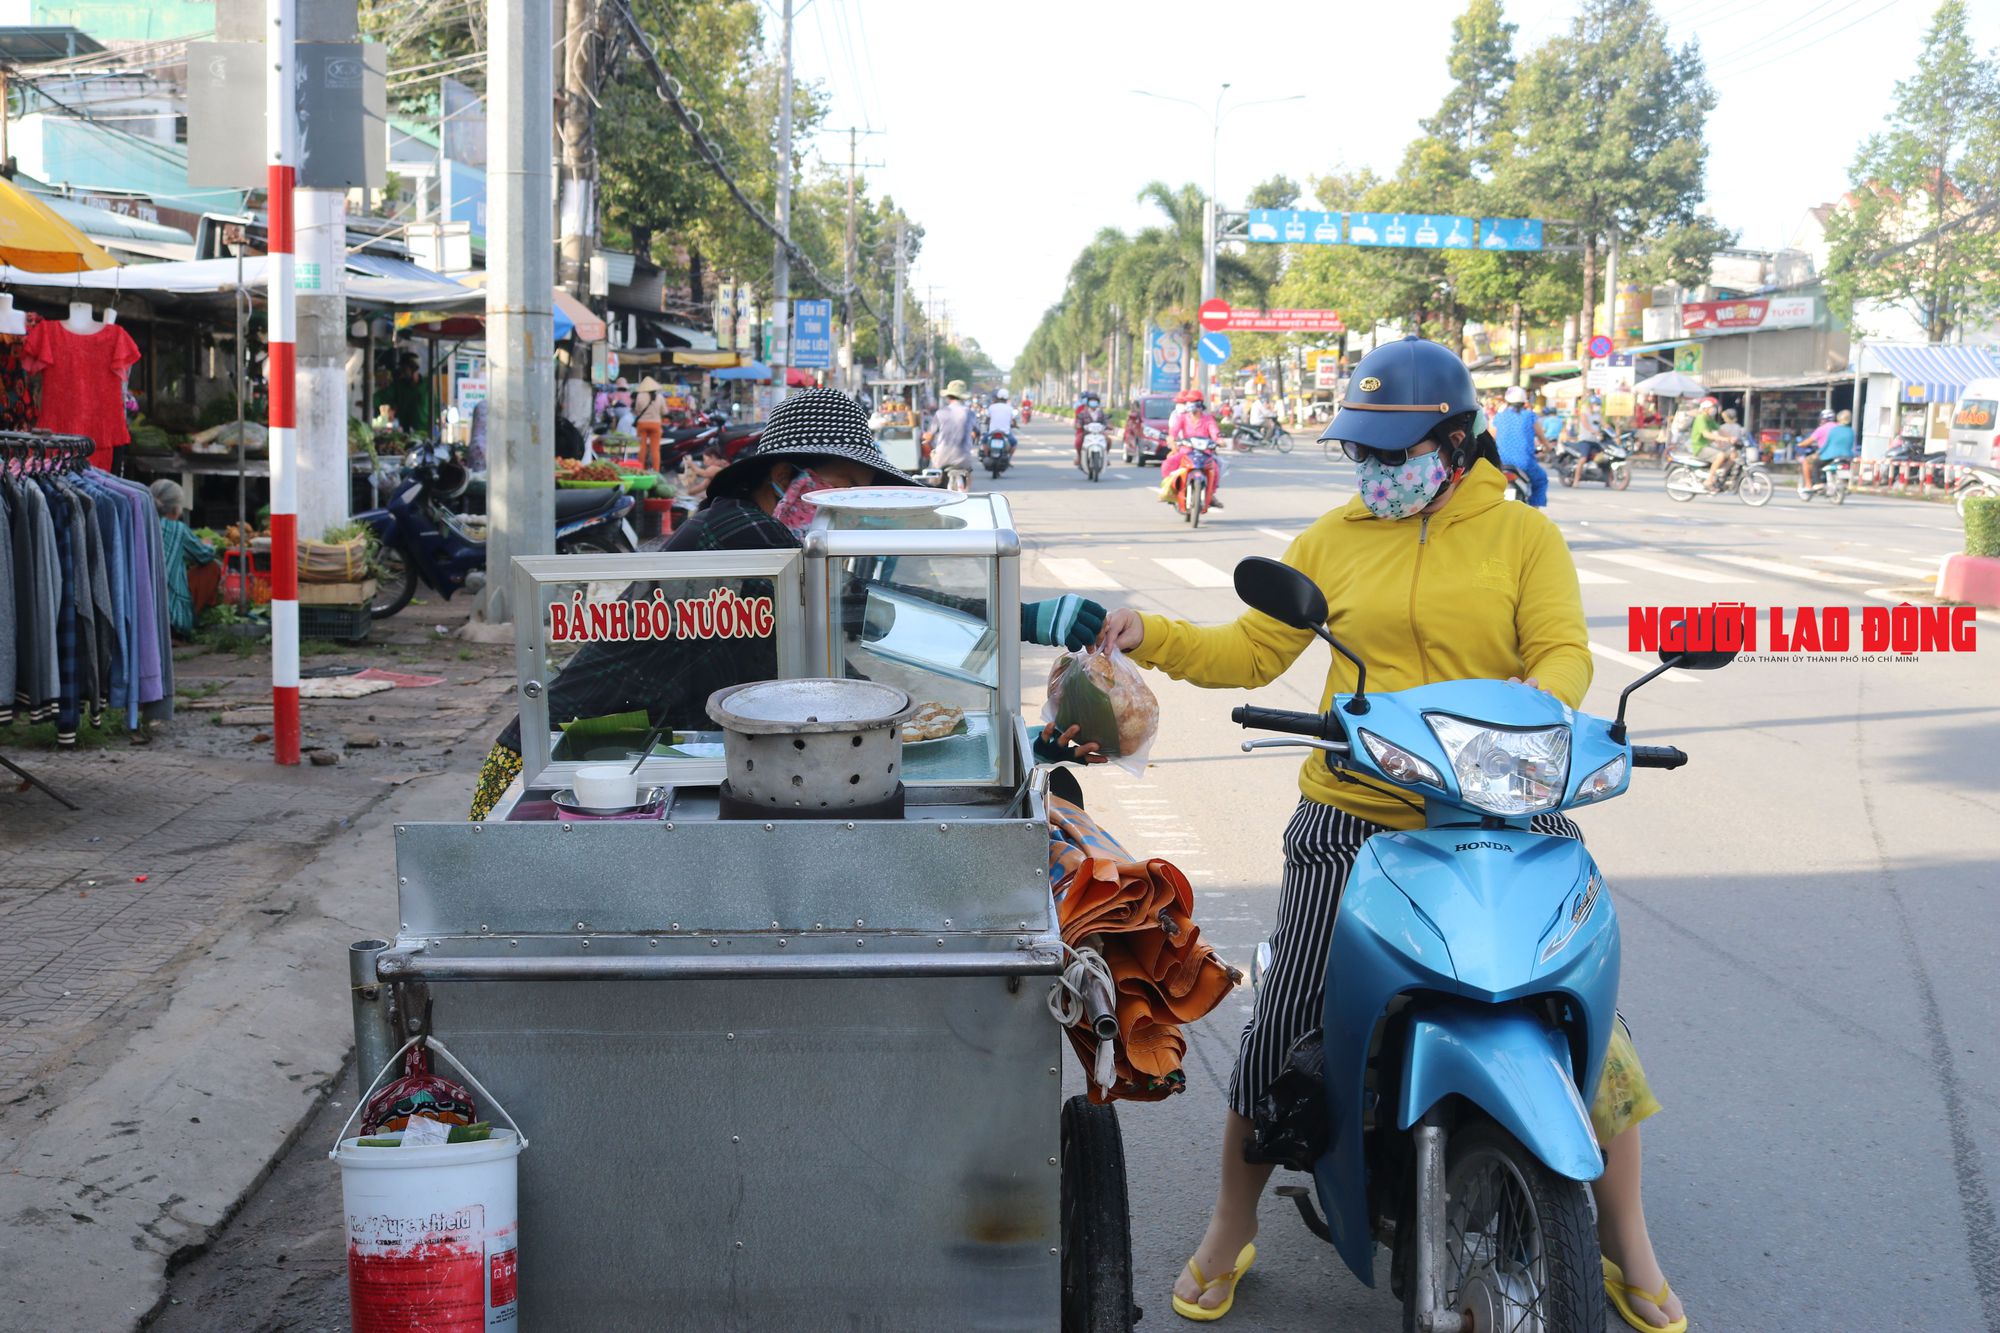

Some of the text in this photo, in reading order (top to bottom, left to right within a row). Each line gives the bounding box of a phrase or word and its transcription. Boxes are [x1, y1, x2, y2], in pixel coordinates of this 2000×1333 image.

[550, 587, 775, 641] BÁNH BÒ NƯỚNG
[1455, 841, 1514, 853] HONDA
